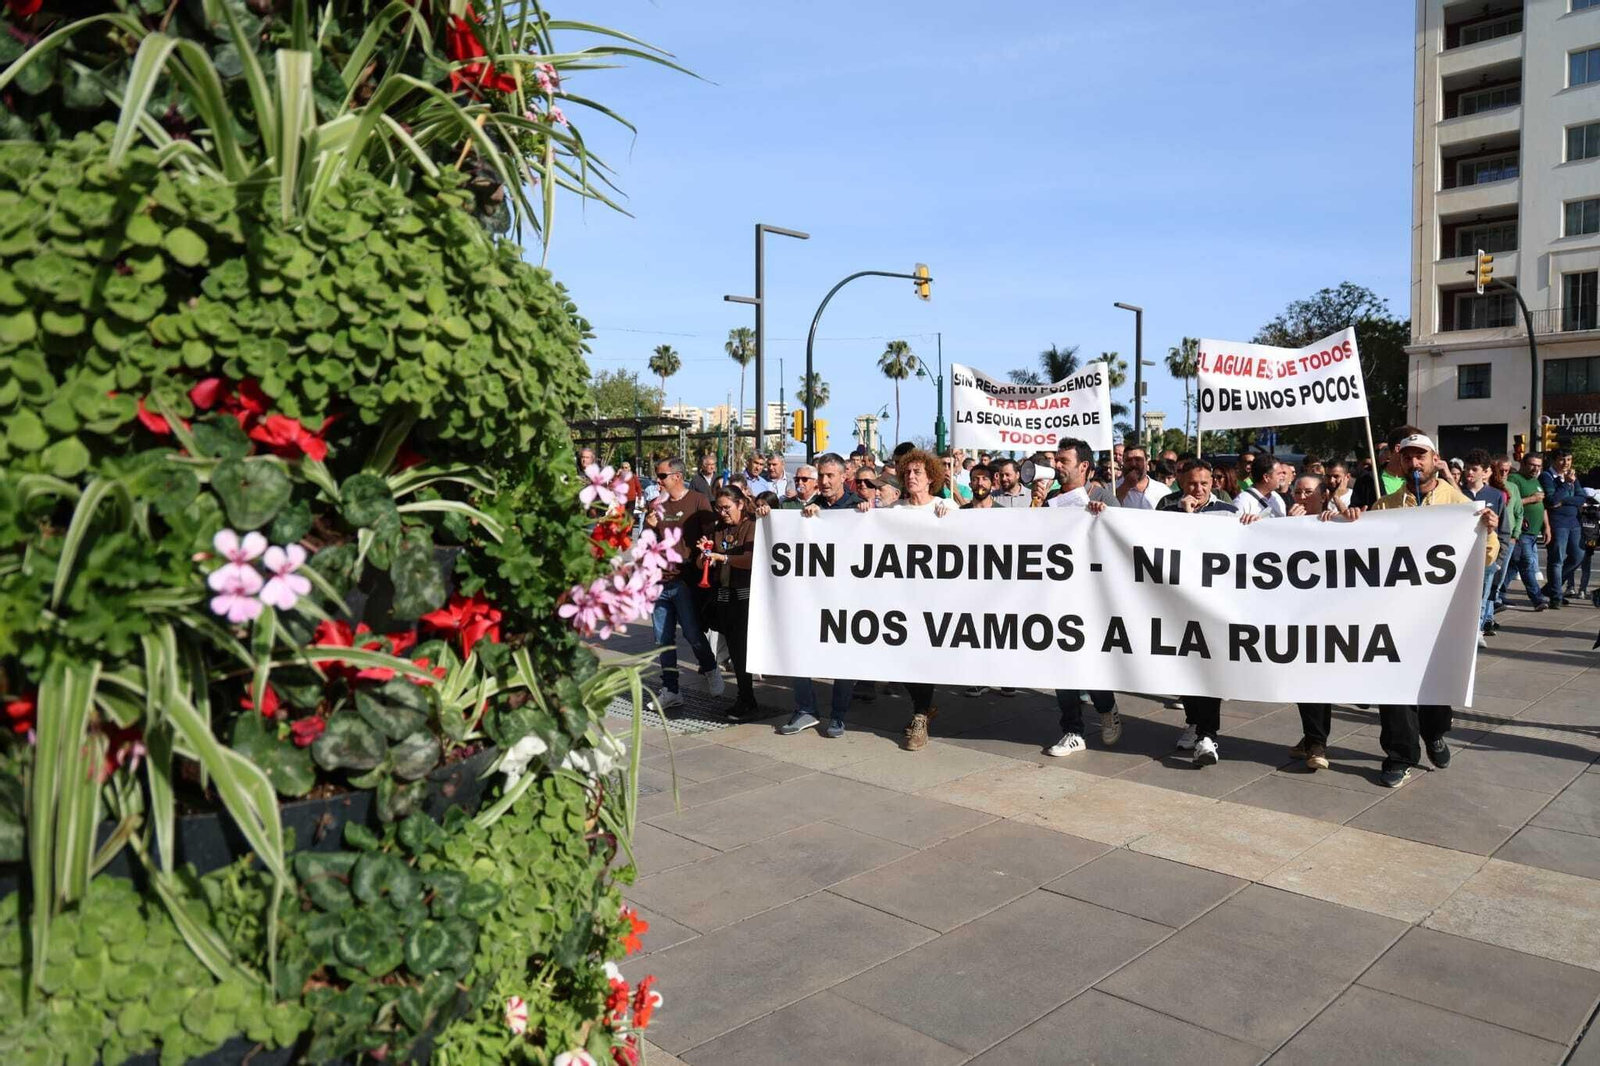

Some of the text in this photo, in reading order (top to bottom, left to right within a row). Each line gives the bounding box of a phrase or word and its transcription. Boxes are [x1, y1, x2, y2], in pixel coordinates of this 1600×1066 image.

[1213, 354, 1252, 377] AGUA
[1256, 359, 1273, 380] ES
[1277, 361, 1297, 378] DE
[1299, 340, 1353, 372] TODOS
[954, 373, 973, 388] SIN
[975, 378, 1016, 395] REGAR
[1219, 388, 1242, 411] DE
[1245, 388, 1296, 411] UNOS
[1299, 375, 1360, 407] POCOS
[986, 396, 1070, 410] TRABAJAR
[956, 410, 973, 424] LA
[1025, 418, 1042, 429] ES
[1044, 413, 1080, 429] COSA
[1082, 411, 1100, 426] DE
[1538, 412, 1600, 430] Only YOU
[999, 431, 1057, 445] TODOS
[771, 543, 1456, 589] SIN JARDINES - NI PISCINAS
[820, 609, 1400, 663] NOS VAMOS A LA RUINA
